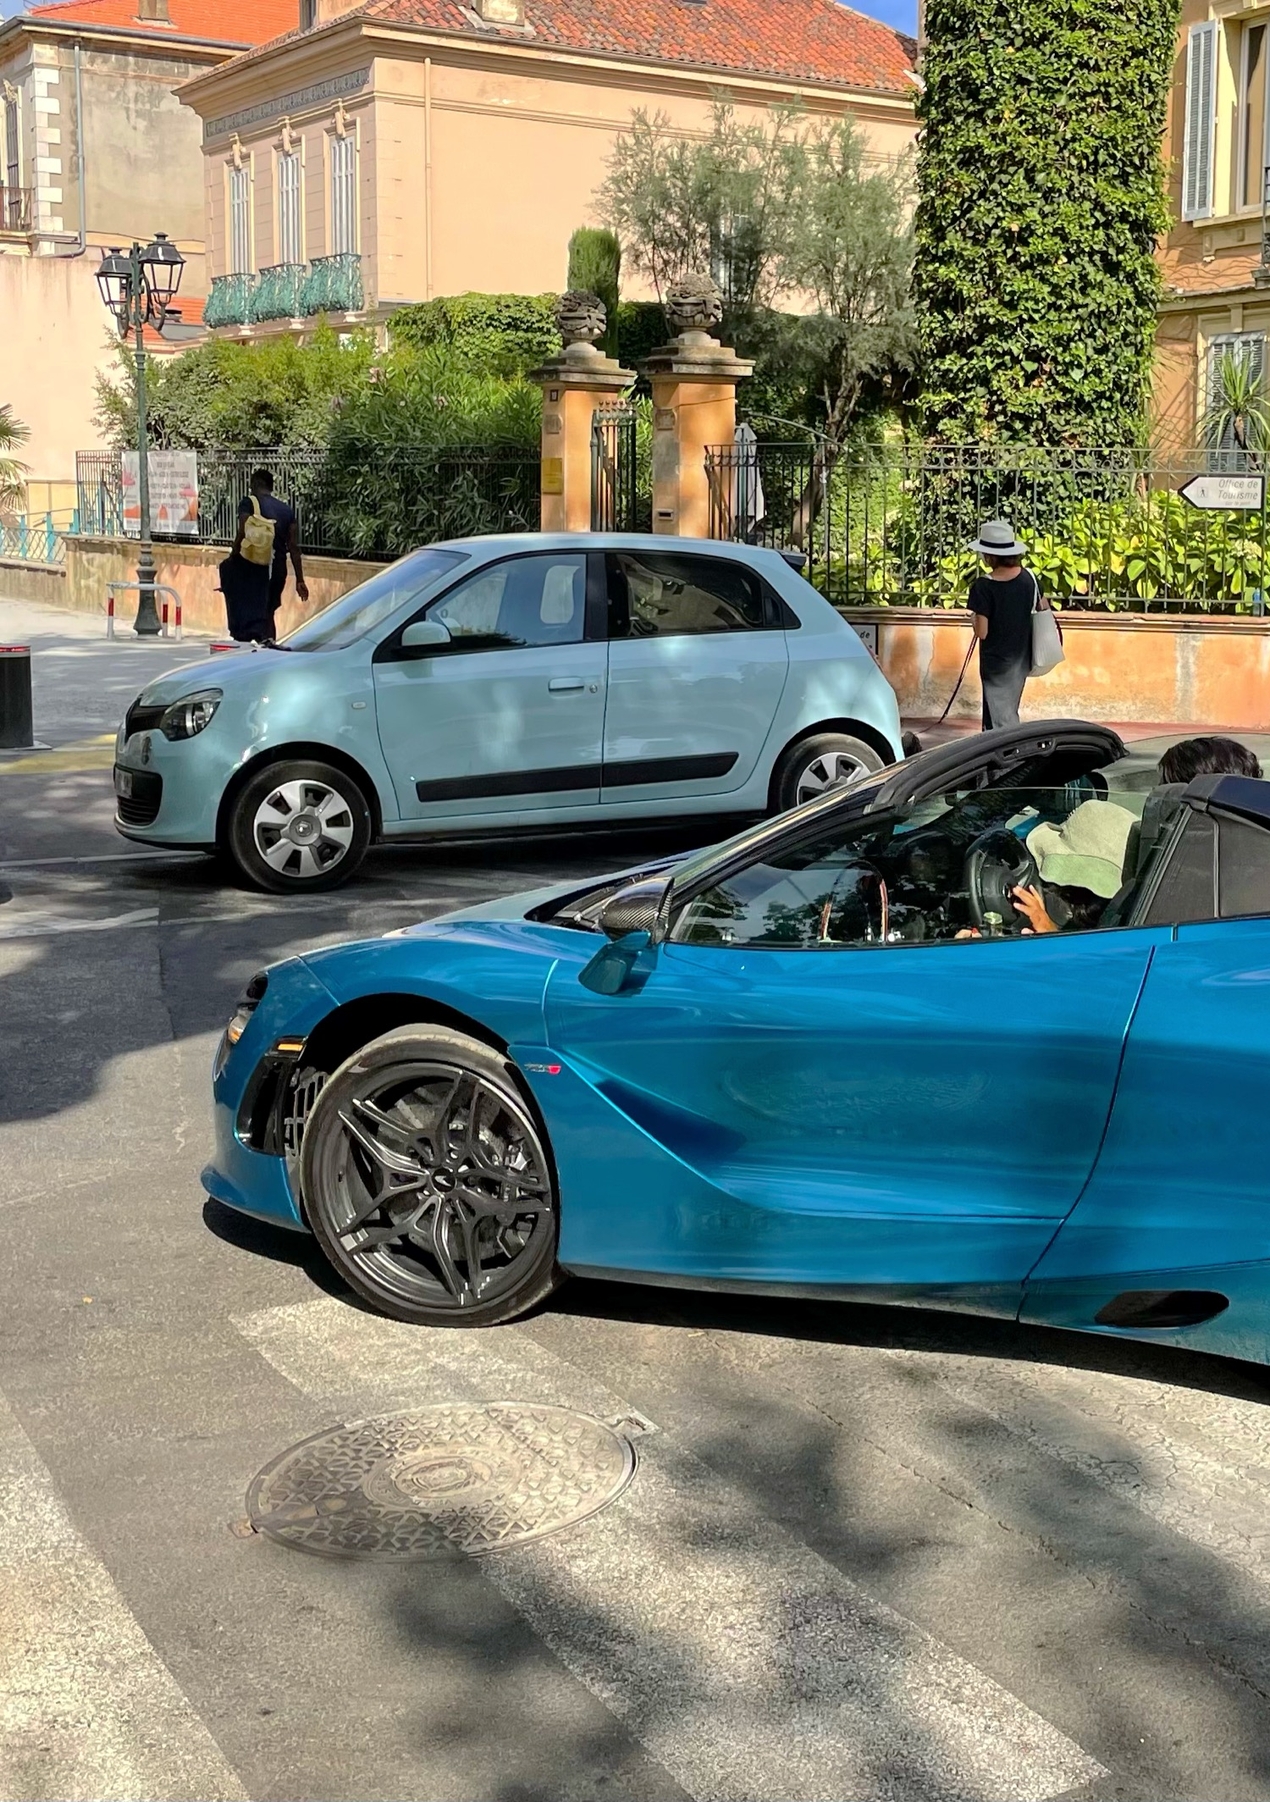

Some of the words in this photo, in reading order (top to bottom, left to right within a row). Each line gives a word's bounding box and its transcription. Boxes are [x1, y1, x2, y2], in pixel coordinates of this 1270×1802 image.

[1218, 479, 1244, 489] Office
[1247, 479, 1258, 489] de
[1218, 490, 1258, 500] Tourisme
